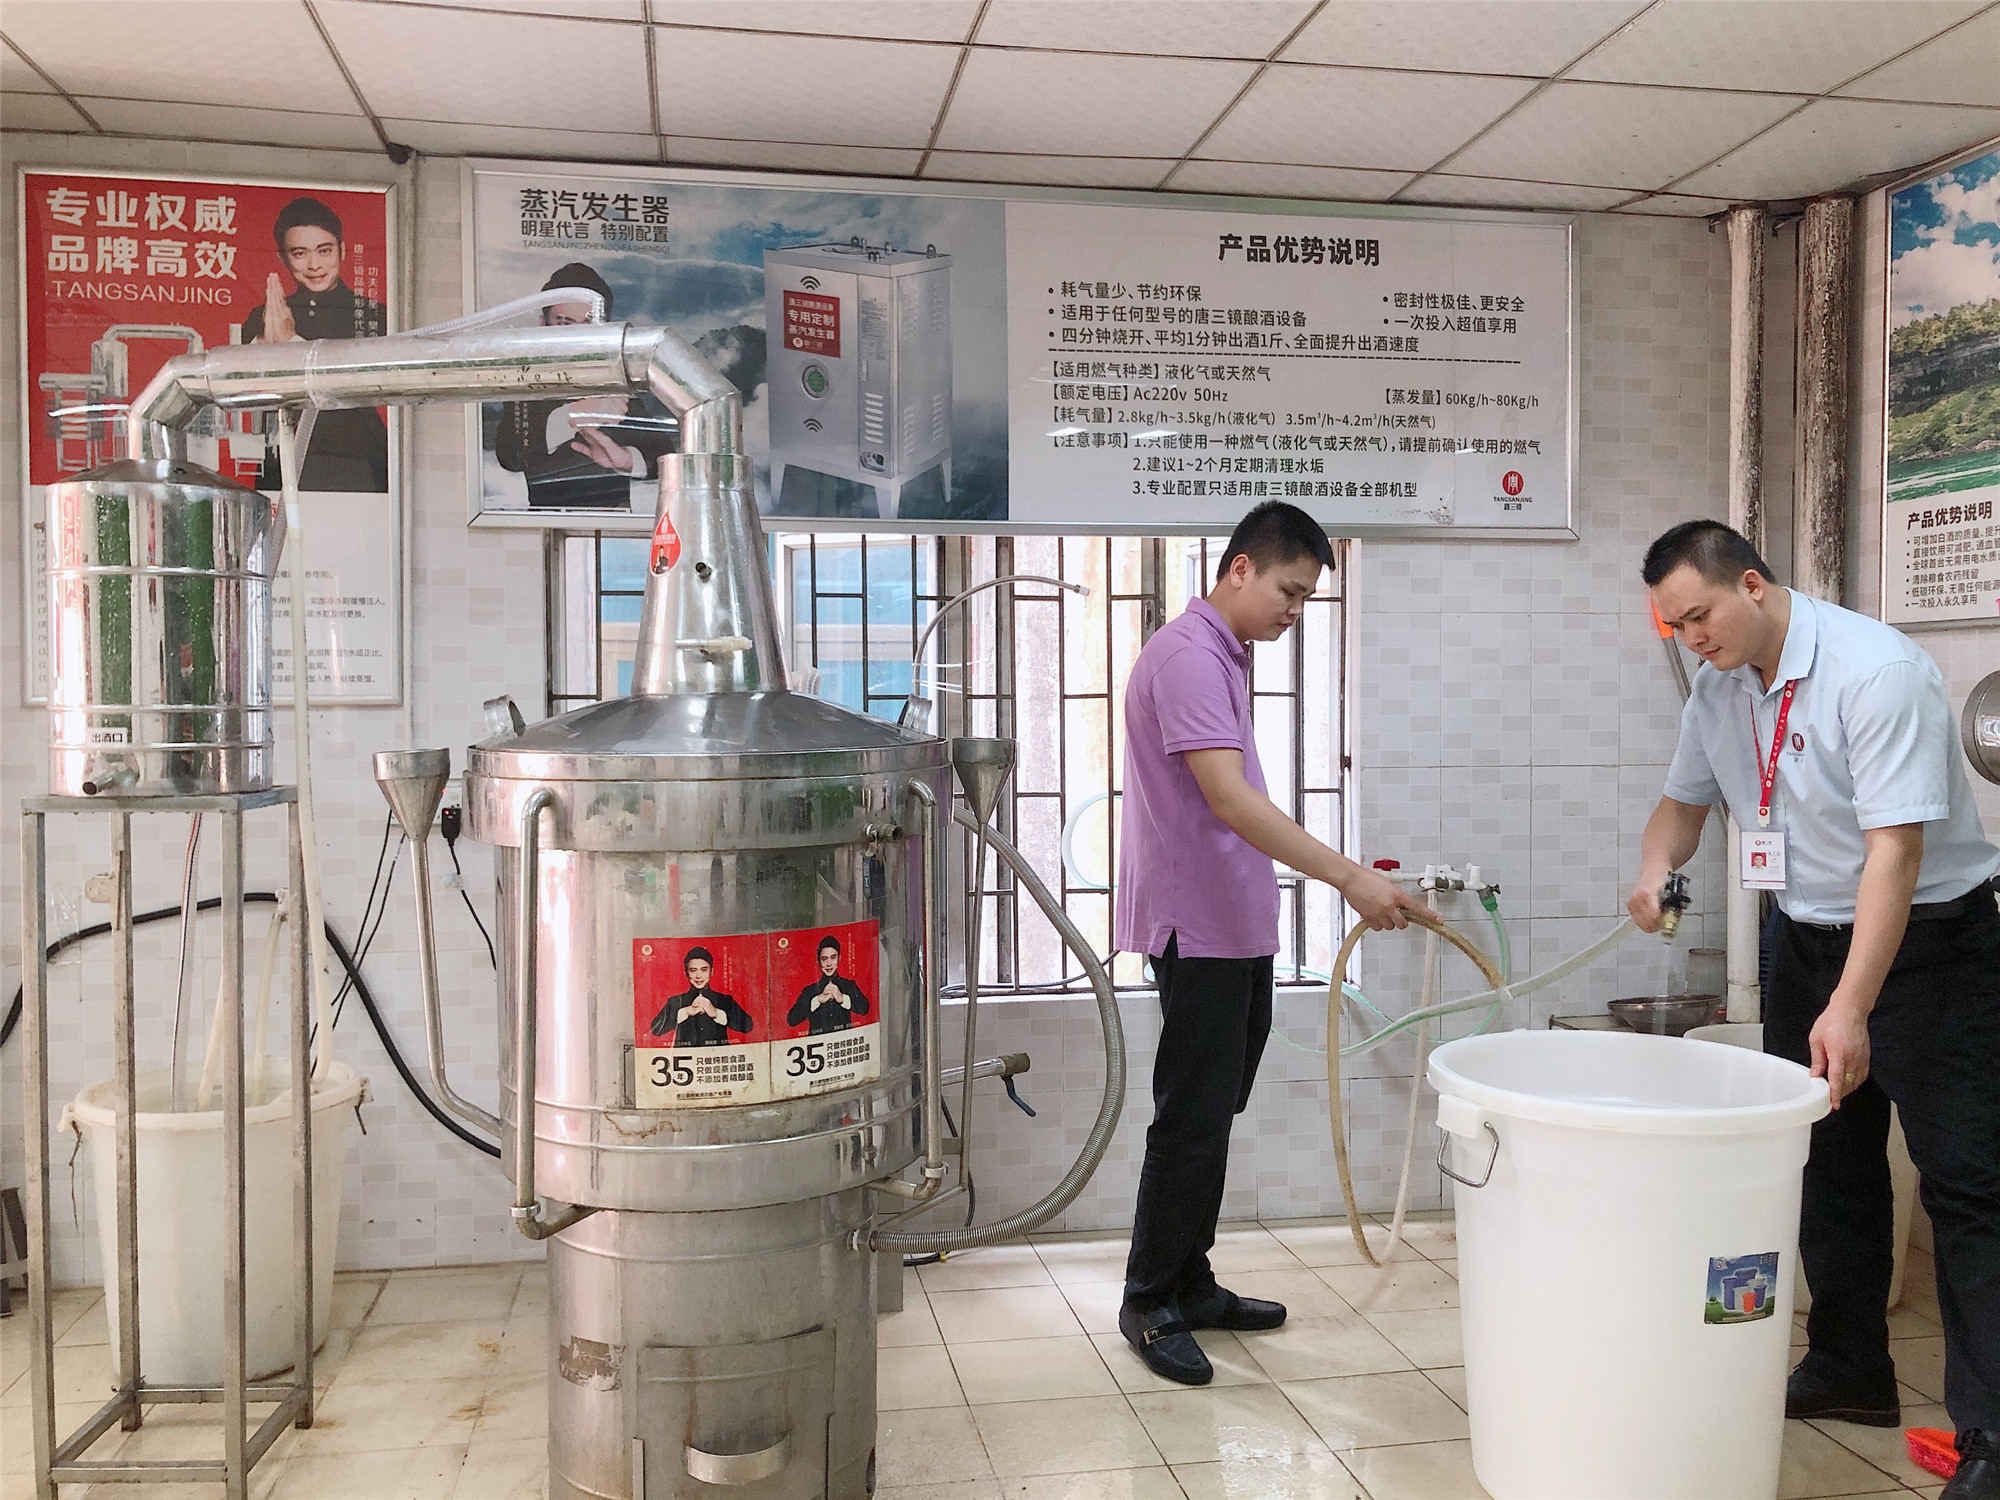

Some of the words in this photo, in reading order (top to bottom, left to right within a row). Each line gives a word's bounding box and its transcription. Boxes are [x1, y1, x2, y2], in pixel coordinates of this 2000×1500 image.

[46, 187, 237, 235] 专业权威
[520, 188, 669, 224] 蒸汽发生器
[521, 221, 590, 239] 明星代言
[601, 223, 669, 243] 特别配置
[48, 235, 237, 280] 品牌高效
[1218, 233, 1379, 266] 产品优势说明
[51, 280, 232, 305] TANGSANJING
[1061, 281, 1201, 302] 耗气量少、节约环保
[1394, 292, 1525, 312] 密封性极佳、更安全
[788, 310, 834, 327] 专用定制
[1061, 303, 1307, 327] 适用于任何型号的唐三镜酿酒设备
[1394, 315, 1517, 333] 一次投入超值享用
[789, 324, 834, 340] 蒸汽发生器
[1062, 327, 1420, 353] 四分钟烧开、平均1分钟出酒1斤、全面提升出酒速度
[1194, 388, 1228, 402] 50Hz
[1132, 457, 1324, 474] 2.建议1~2个月定期清理水垢
[1132, 480, 1417, 498] 3.专业配置只适用唐三镜酿酒设备全部机型
[1907, 500, 1992, 530] 产品优势说明
[1912, 568, 1979, 585] 清除粮食农药残留
[1911, 594, 1978, 609] 一次投入永久享用
[92, 733, 122, 742] 出酒口
[696, 1054, 745, 1066] 只做纯粮食酒
[696, 1063, 754, 1075] 只做现蒸自酿酒
[786, 1042, 825, 1077] 35
[651, 1056, 694, 1087] 35
